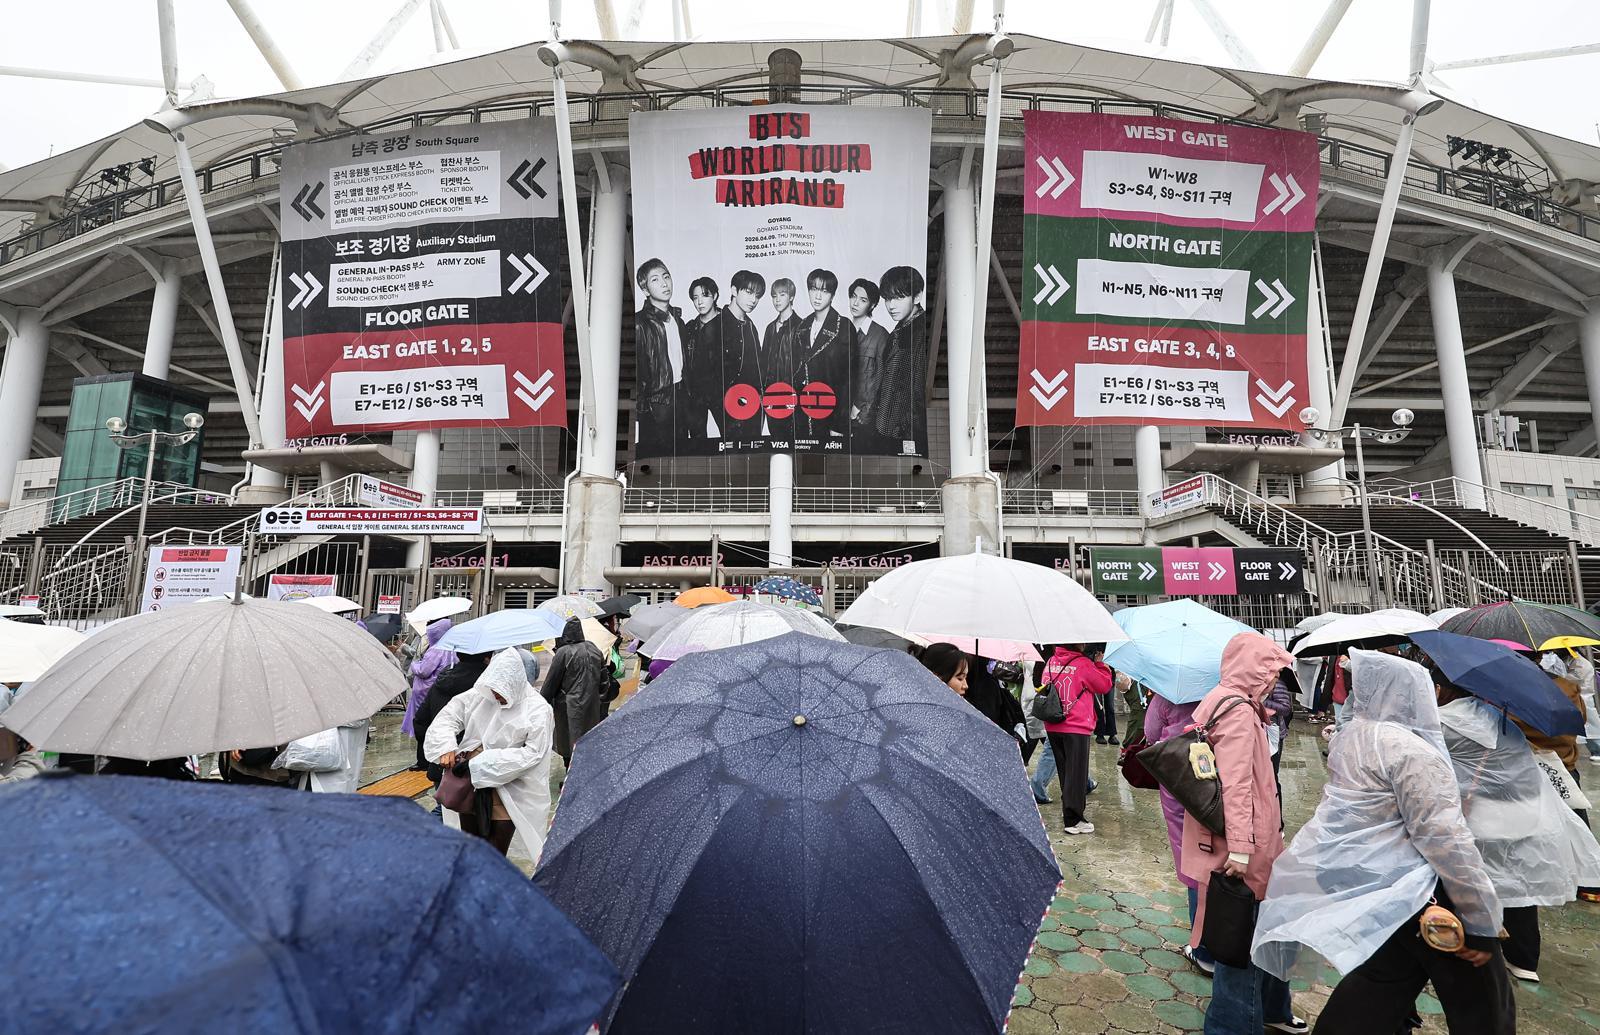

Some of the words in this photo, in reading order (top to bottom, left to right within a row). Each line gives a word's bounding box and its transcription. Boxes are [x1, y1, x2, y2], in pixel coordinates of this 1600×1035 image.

[757, 113, 802, 141] BTS
[416, 138, 442, 147] South
[446, 136, 479, 145] Square
[1124, 125, 1176, 141] WEST
[1182, 131, 1228, 147] GATE
[352, 140, 378, 157] 남측
[382, 135, 411, 153] 광장
[441, 158, 462, 166] 협찬사
[465, 157, 480, 165] 부스
[699, 144, 784, 176] WORLD
[796, 144, 860, 172] TOUR
[334, 170, 347, 181] 공식
[372, 164, 407, 174] 익스프레스
[409, 161, 423, 170] 부스
[1148, 167, 1198, 184] W1~W8
[441, 177, 470, 186] 티켓박스
[334, 190, 347, 199] 공식
[350, 187, 363, 196] 앨범
[366, 185, 379, 195] 현장
[397, 182, 412, 190] 부스
[725, 177, 835, 207] ARIRANG
[1109, 183, 1157, 200] S3~S4,
[1160, 187, 1205, 203] S9~S11
[1209, 191, 1232, 205] 구역
[335, 209, 348, 218] 앨범
[350, 207, 364, 215] 예약
[367, 204, 387, 214] 구매자
[389, 201, 417, 211] SOUND
[420, 198, 447, 207] CHECK
[450, 196, 472, 205] 이벤트
[474, 196, 488, 204] 부스
[335, 240, 365, 256] 보조
[369, 234, 411, 255] 경기장
[416, 236, 455, 248] Auxiliary
[458, 234, 495, 244] Stadium
[1109, 233, 1169, 252] NORTH
[1174, 239, 1220, 255] GATE
[338, 268, 377, 276] GENERAL
[379, 264, 411, 274] IN-PASS
[412, 261, 424, 270] 부스
[464, 257, 485, 265] ZONE
[422, 280, 434, 288] 부스
[1102, 282, 1145, 298] N1~N5,
[1149, 285, 1197, 298] N6~N11
[1202, 288, 1223, 302] 구역
[366, 309, 422, 326] FLOOR
[426, 304, 469, 320] GATE
[343, 344, 390, 359] EAST
[395, 340, 437, 357] GATE
[442, 339, 456, 355] 1,
[461, 338, 477, 355] 2,
[482, 338, 492, 352] 5
[1088, 336, 1129, 352] EAST
[1134, 339, 1179, 355] GATE
[1184, 342, 1200, 358] 3,
[1206, 343, 1219, 359] 4,
[1225, 345, 1235, 357] 8
[360, 383, 403, 395] E1~E6
[406, 382, 411, 394] /
[414, 380, 452, 392] S1~S3
[456, 378, 478, 391] 구역
[1104, 377, 1143, 388] E1~E6
[1147, 379, 1151, 390] /
[1155, 379, 1194, 391] S1~S3
[1198, 381, 1219, 394] 구역
[355, 399, 405, 411] E7~E12
[408, 398, 413, 410] /
[416, 396, 457, 408] S6~S8
[461, 394, 483, 407] 구역
[1100, 393, 1147, 404] E7~E12
[1151, 394, 1154, 405] /
[1158, 396, 1200, 407] S6~S8
[1205, 397, 1225, 409] 구역
[311, 437, 339, 447] GATE
[339, 433, 347, 445] 6
[1229, 434, 1258, 445] EAST
[1262, 436, 1290, 446] GATE
[1294, 434, 1300, 446] 7
[434, 557, 465, 567] EAST
[502, 554, 509, 568] 1
[644, 556, 676, 566] EAST
[680, 556, 712, 566] GATE
[832, 557, 863, 567] EAST
[869, 557, 902, 567] GATE
